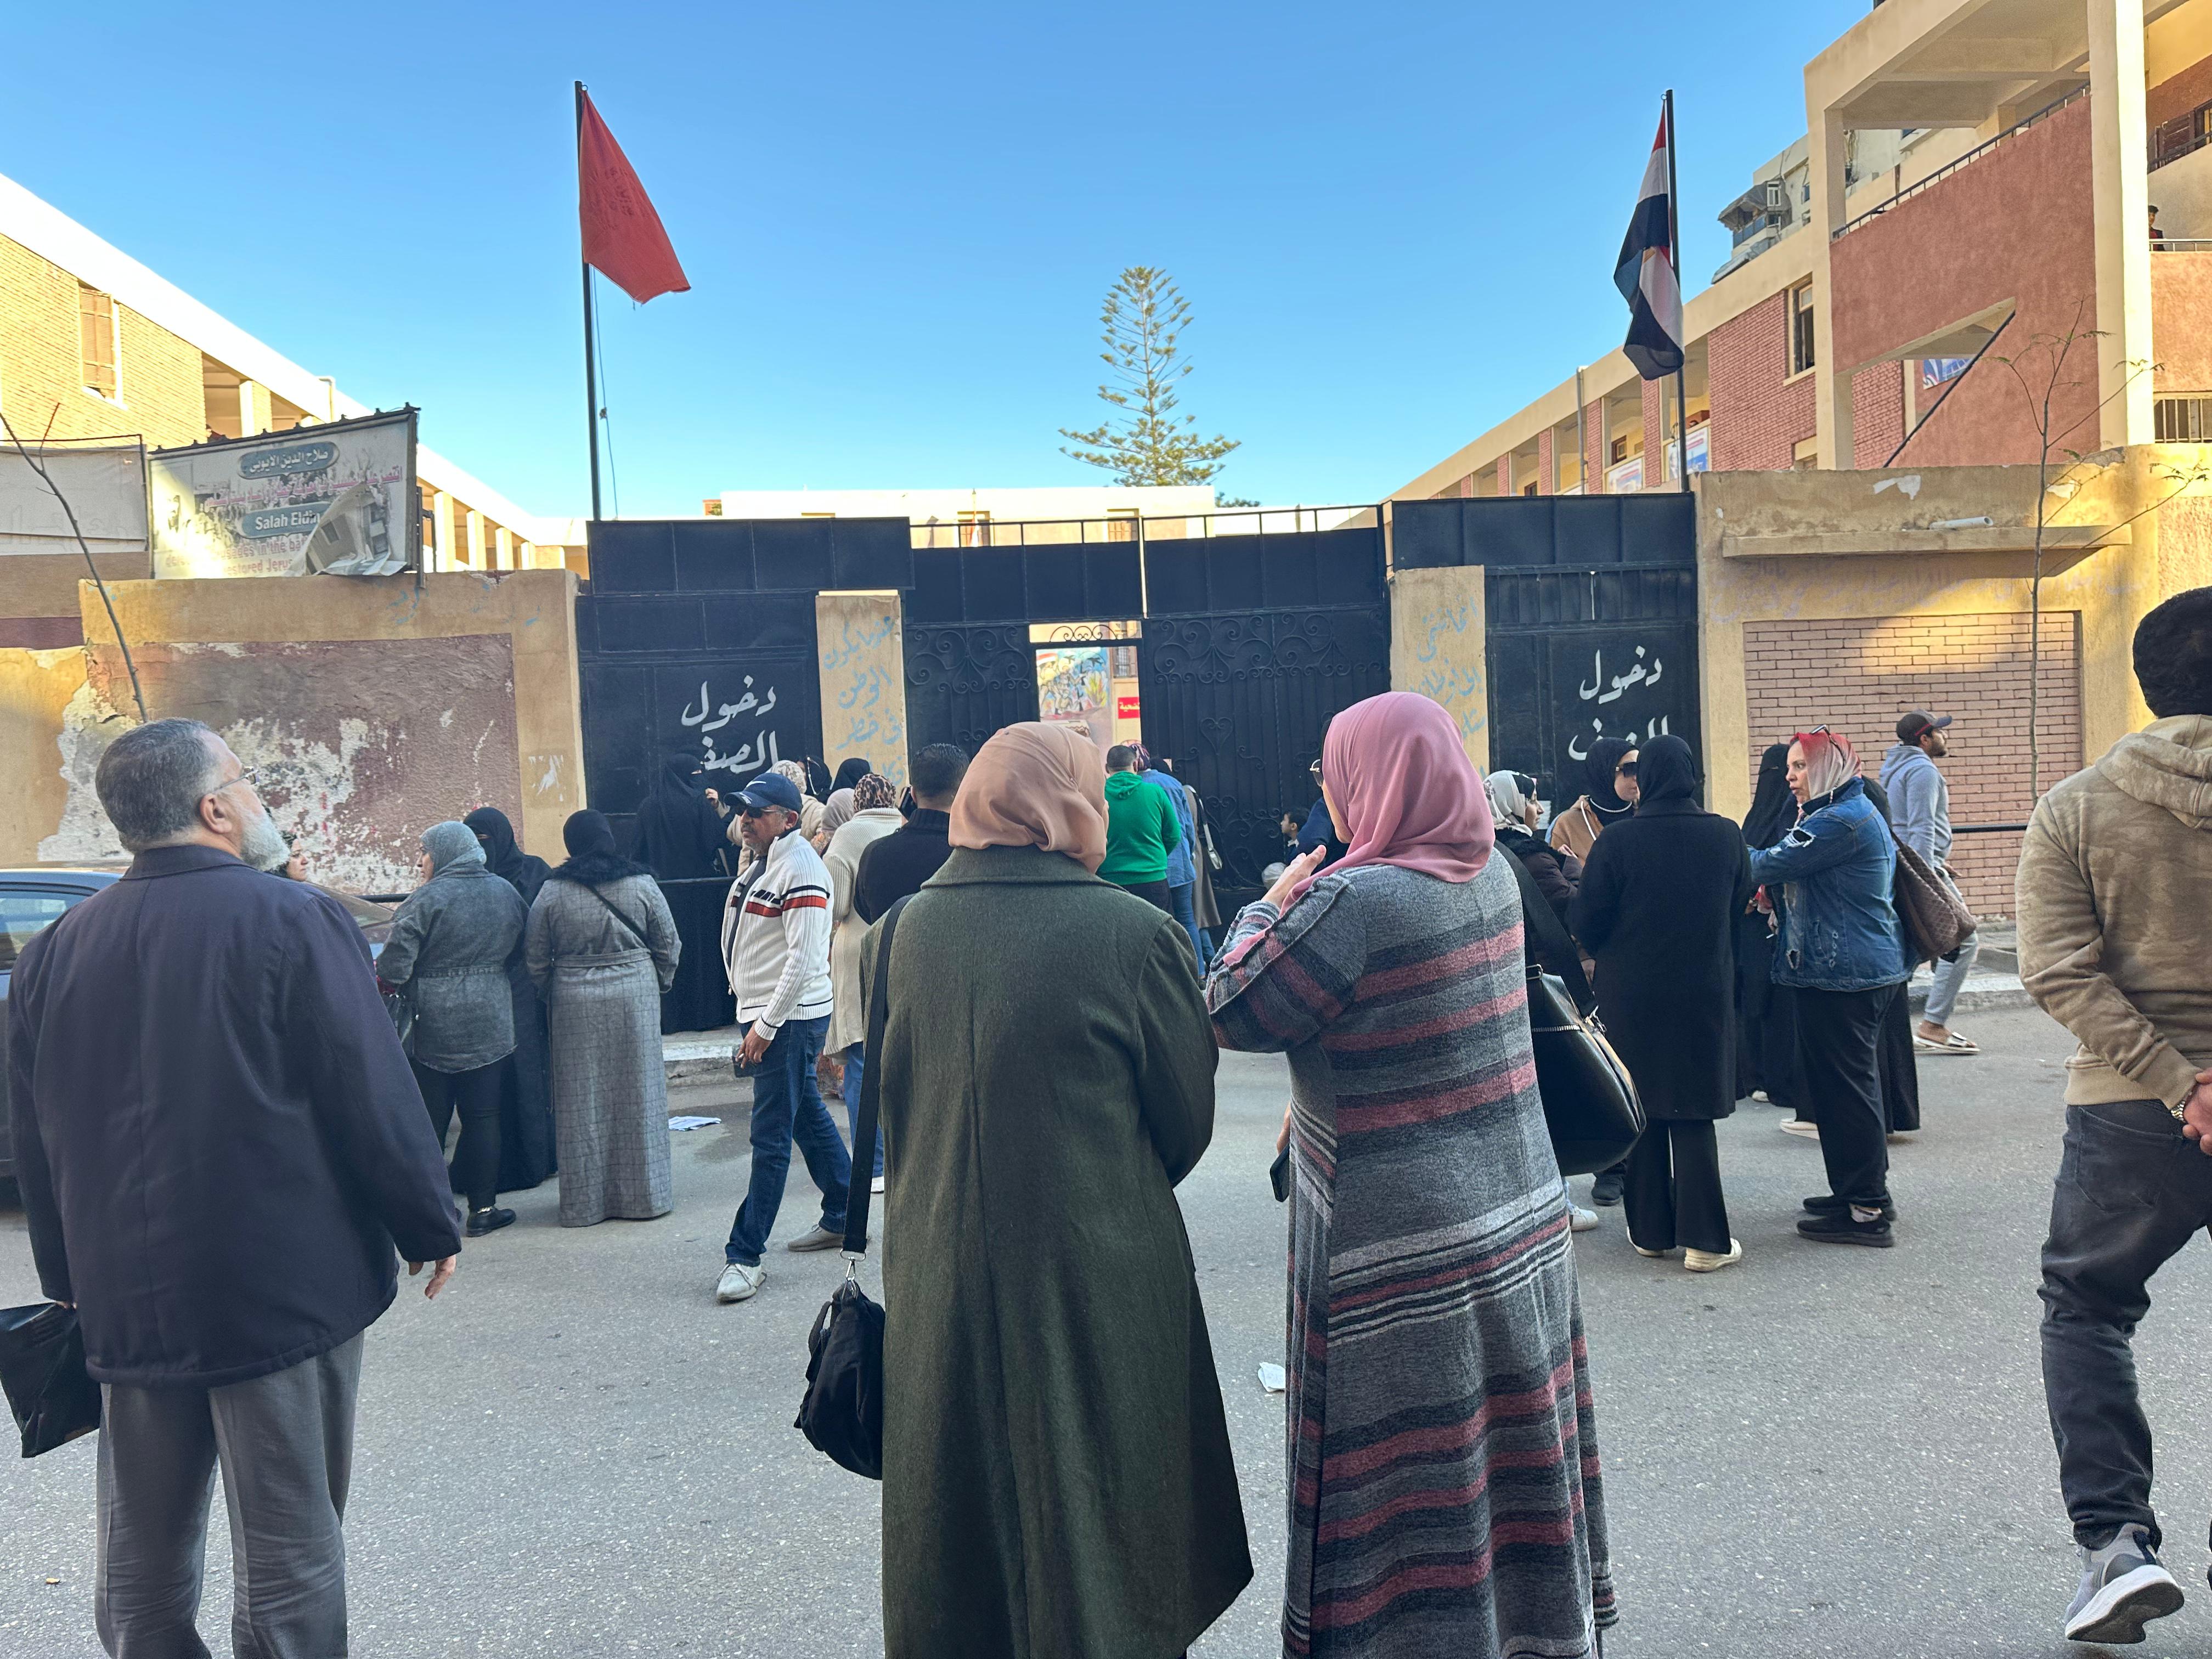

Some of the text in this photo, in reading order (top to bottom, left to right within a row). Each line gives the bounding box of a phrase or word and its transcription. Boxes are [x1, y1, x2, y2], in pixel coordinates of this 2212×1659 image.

[280, 452, 305, 469] الدين
[306, 449, 329, 465] صلاح
[255, 514, 288, 531] Salah
[838, 665, 893, 709] الوطن
[1579, 645, 1662, 704] دخول
[681, 675, 777, 732] دخول
[836, 710, 880, 752] خطر
